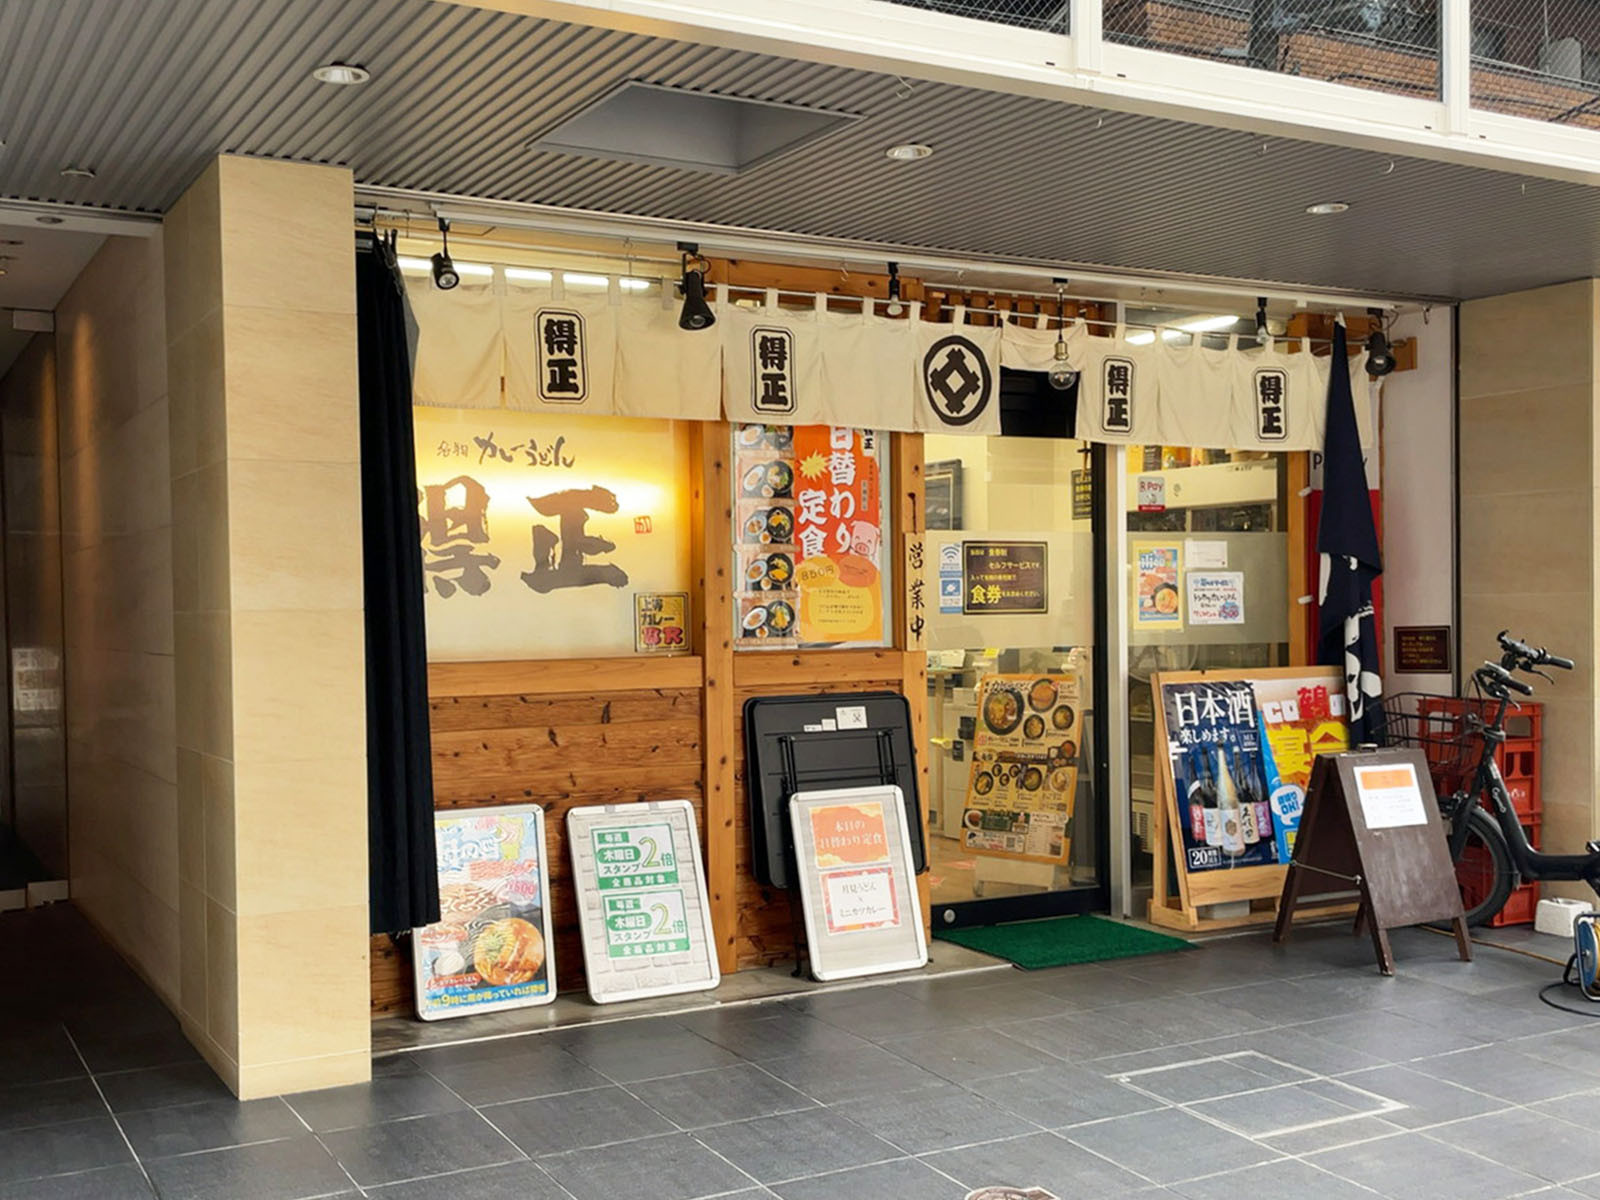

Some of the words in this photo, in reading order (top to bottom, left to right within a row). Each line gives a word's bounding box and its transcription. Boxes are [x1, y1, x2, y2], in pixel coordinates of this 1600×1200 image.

[544, 318, 579, 394] 得正
[758, 334, 789, 406] 得正
[1106, 364, 1130, 428] 得正
[1259, 375, 1283, 435] 得正
[827, 427, 857, 554] 日替わり
[798, 488, 828, 558] 定食
[908, 541, 926, 642] 営業中
[1173, 685, 1256, 729] 日本酒
[603, 848, 635, 861] 木曜日
[603, 863, 641, 875] スタンプ
[611, 874, 666, 887] 全商品対象
[614, 931, 651, 942] スタンプ
[615, 915, 646, 928] 木曜日
